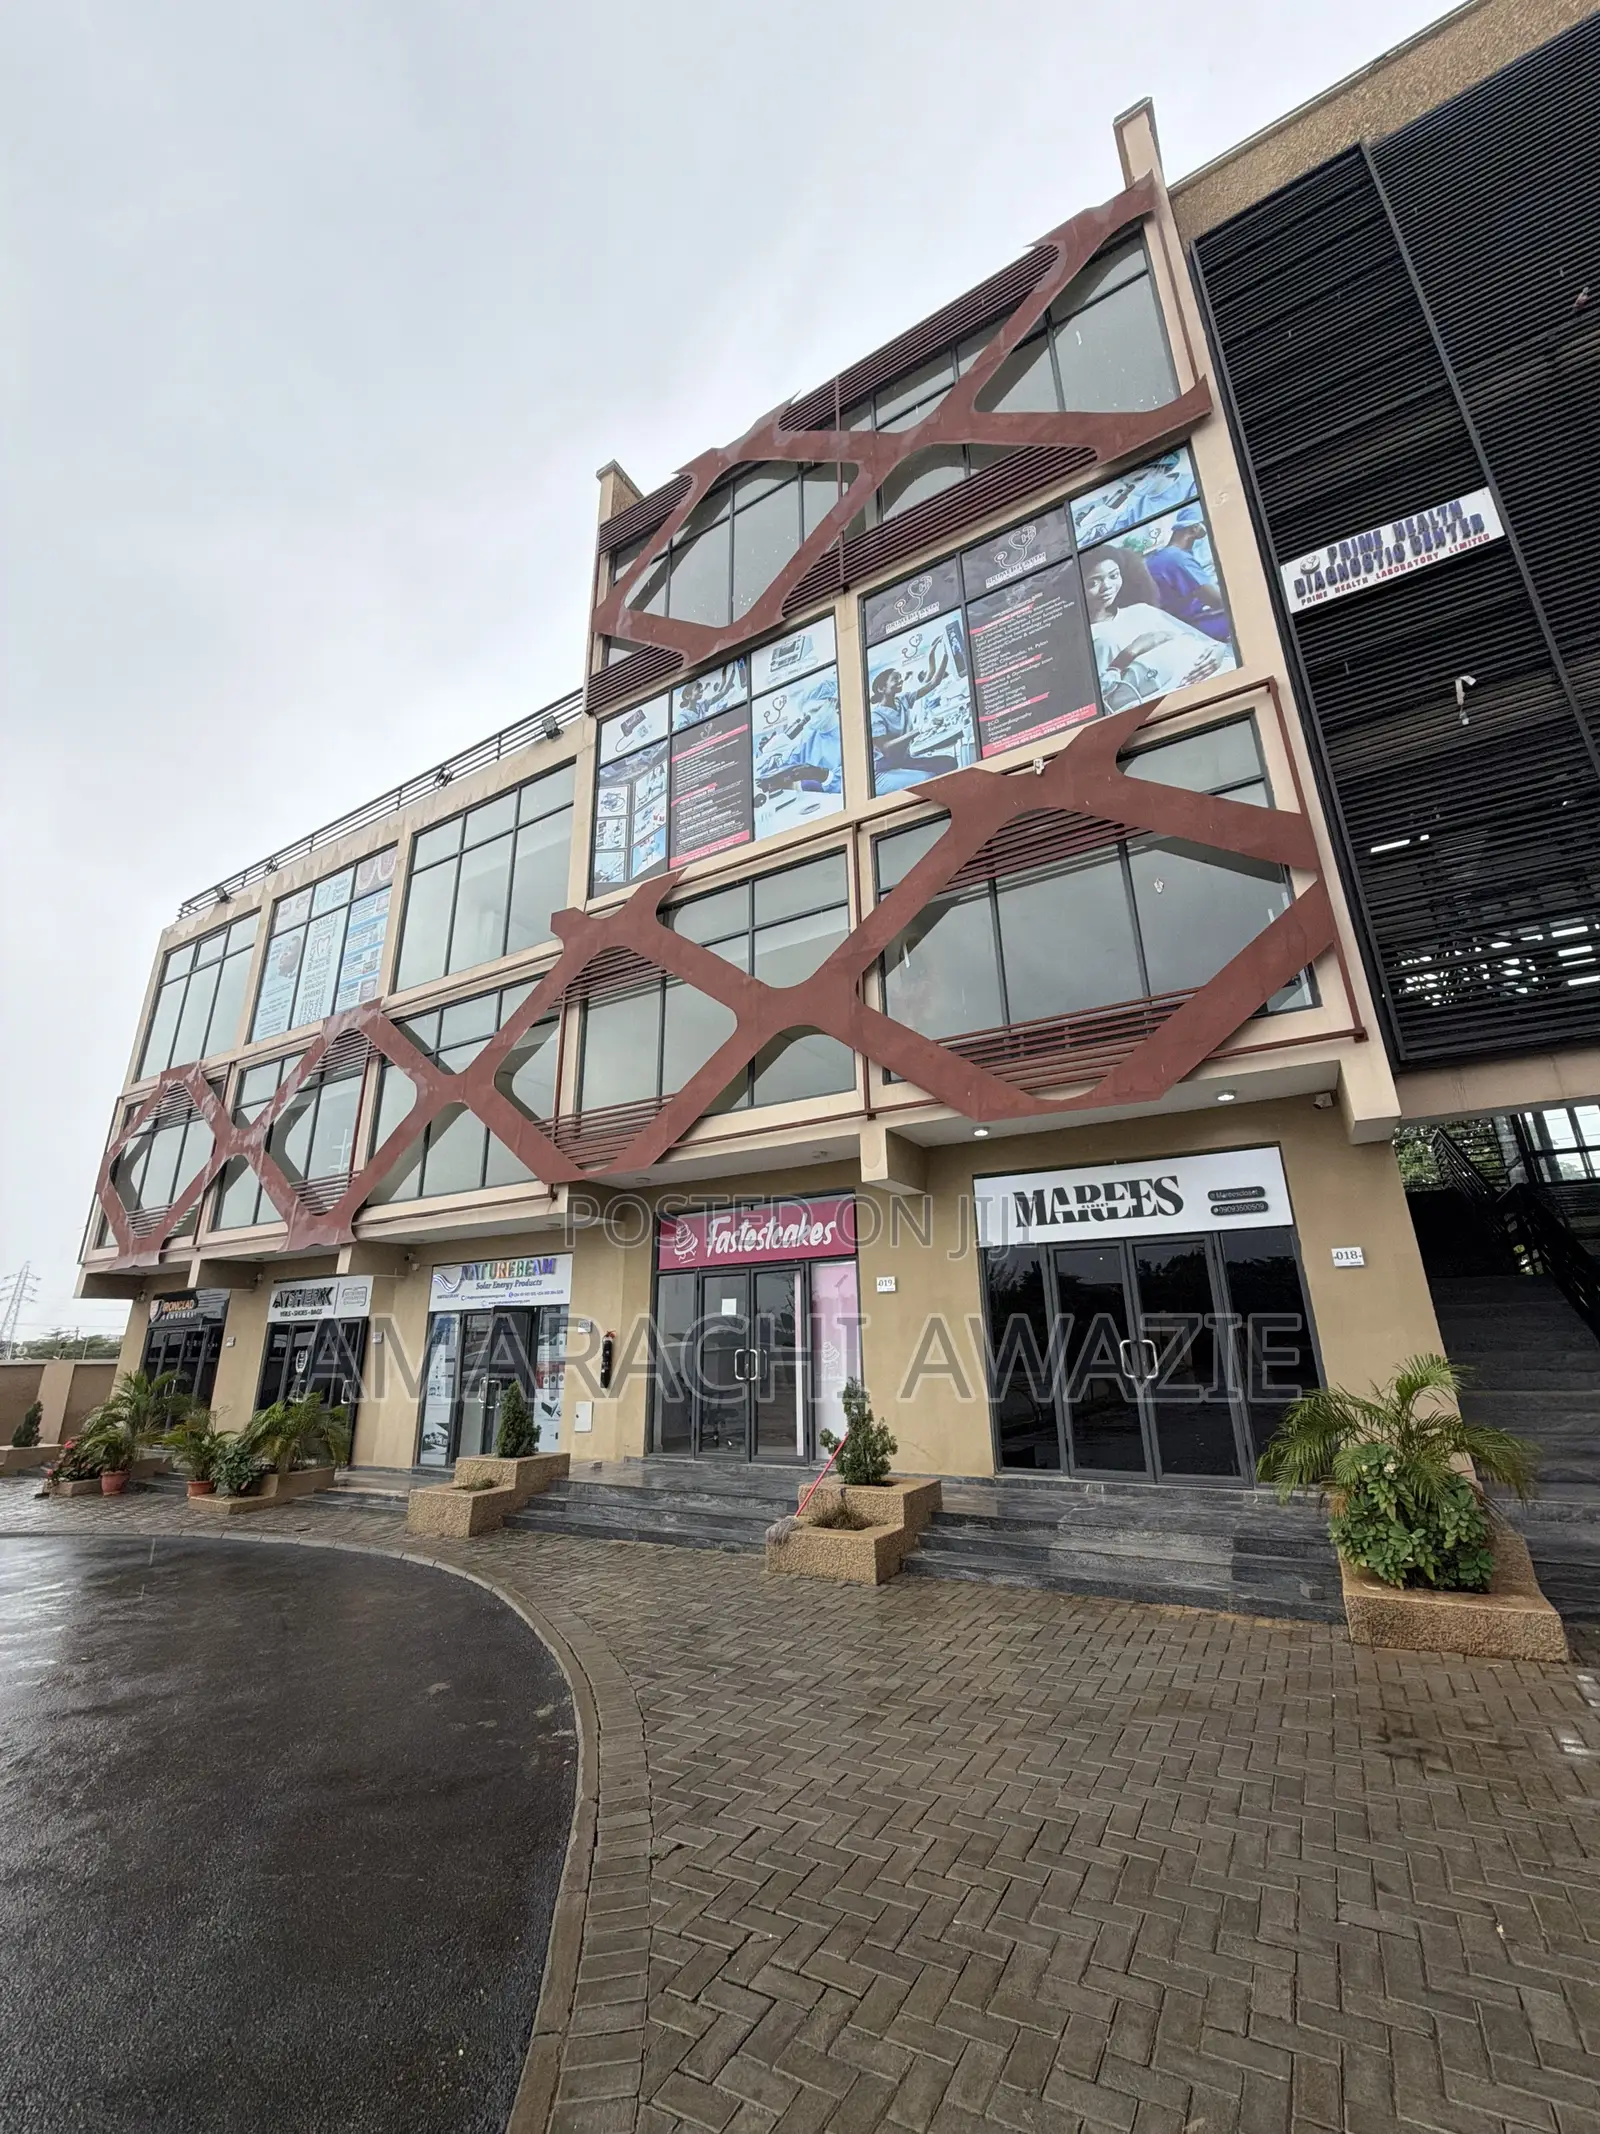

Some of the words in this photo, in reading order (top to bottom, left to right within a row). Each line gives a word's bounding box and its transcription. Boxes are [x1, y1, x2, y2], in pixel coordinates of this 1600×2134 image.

[1294, 542, 1406, 599] DIAGNOSTIC
[1409, 513, 1485, 556] CENTER
[1327, 530, 1383, 566] PRIME
[1392, 500, 1463, 542] HEALTH
[1302, 591, 1328, 606] PRIME
[1335, 577, 1368, 594] HEALTH
[1376, 552, 1439, 580] LABORATORY
[1448, 533, 1490, 554] LIMITED
[1012, 1176, 1184, 1229] MAREES
[707, 1212, 837, 1258] Fastestcakes
[460, 1258, 556, 1281] NATUREBEAM
[476, 1282, 490, 1290] Solar
[492, 1281, 513, 1290] Energy
[514, 1278, 542, 1288] Products
